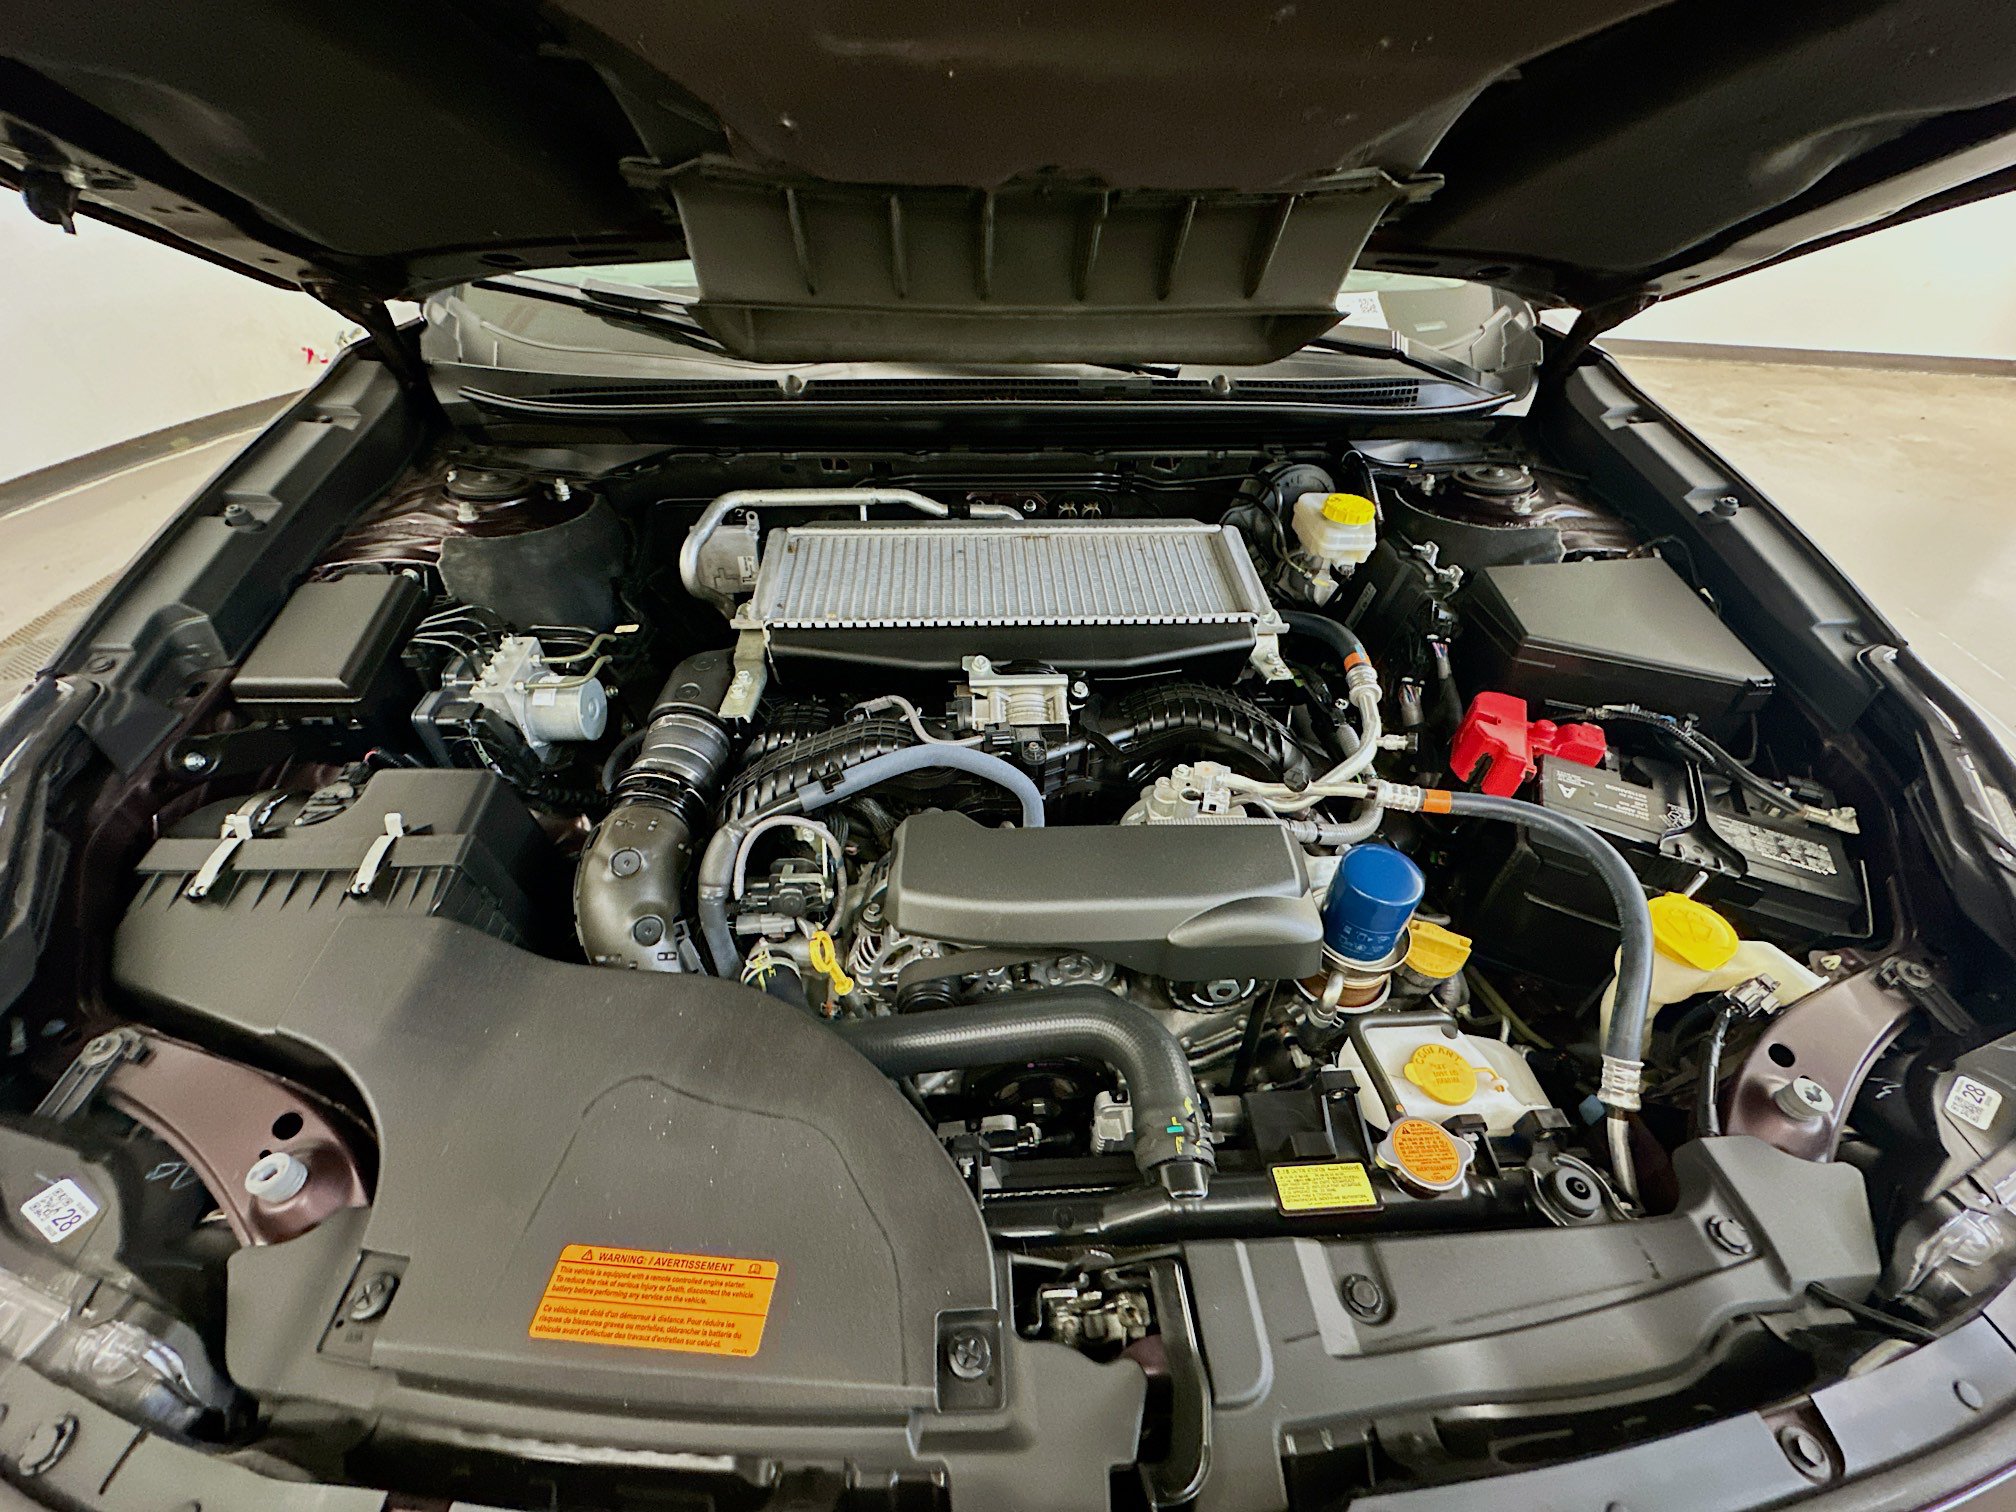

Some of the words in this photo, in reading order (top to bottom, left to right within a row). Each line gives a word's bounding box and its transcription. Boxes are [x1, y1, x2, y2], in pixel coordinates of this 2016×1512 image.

[1962, 1084, 1986, 1104] 28
[51, 1208, 82, 1232] 28
[654, 1257, 734, 1271] AVERTISSEMENT
[560, 1266, 572, 1274] This
[574, 1267, 594, 1277] vehicle
[603, 1271, 630, 1280] equipped
[672, 1275, 701, 1284] controlled
[703, 1278, 723, 1287] engine
[566, 1276, 584, 1285] reduce
[617, 1281, 639, 1289] serious
[687, 1285, 719, 1294] disconnect
[732, 1289, 754, 1298] vehicle
[552, 1284, 572, 1294] battery
[574, 1286, 592, 1295] before
[594, 1288, 628, 1299] performing
[641, 1293, 662, 1301] service
[684, 1295, 706, 1304] vehicle.
[539, 1314, 562, 1324] risques
[572, 1317, 602, 1326] blessures
[604, 1320, 624, 1330] graves
[708, 1329, 732, 1338] batterie
[543, 1304, 552, 1312] Ce
[553, 1305, 577, 1315] véhicule
[606, 1309, 618, 1318] d'un
[620, 1311, 650, 1321] démarreur
[687, 1317, 701, 1325] Pour
[703, 1318, 724, 1327] réduire
[535, 1324, 562, 1334] véhicule
[563, 1327, 579, 1336] avant
[627, 1332, 650, 1342] travaux
